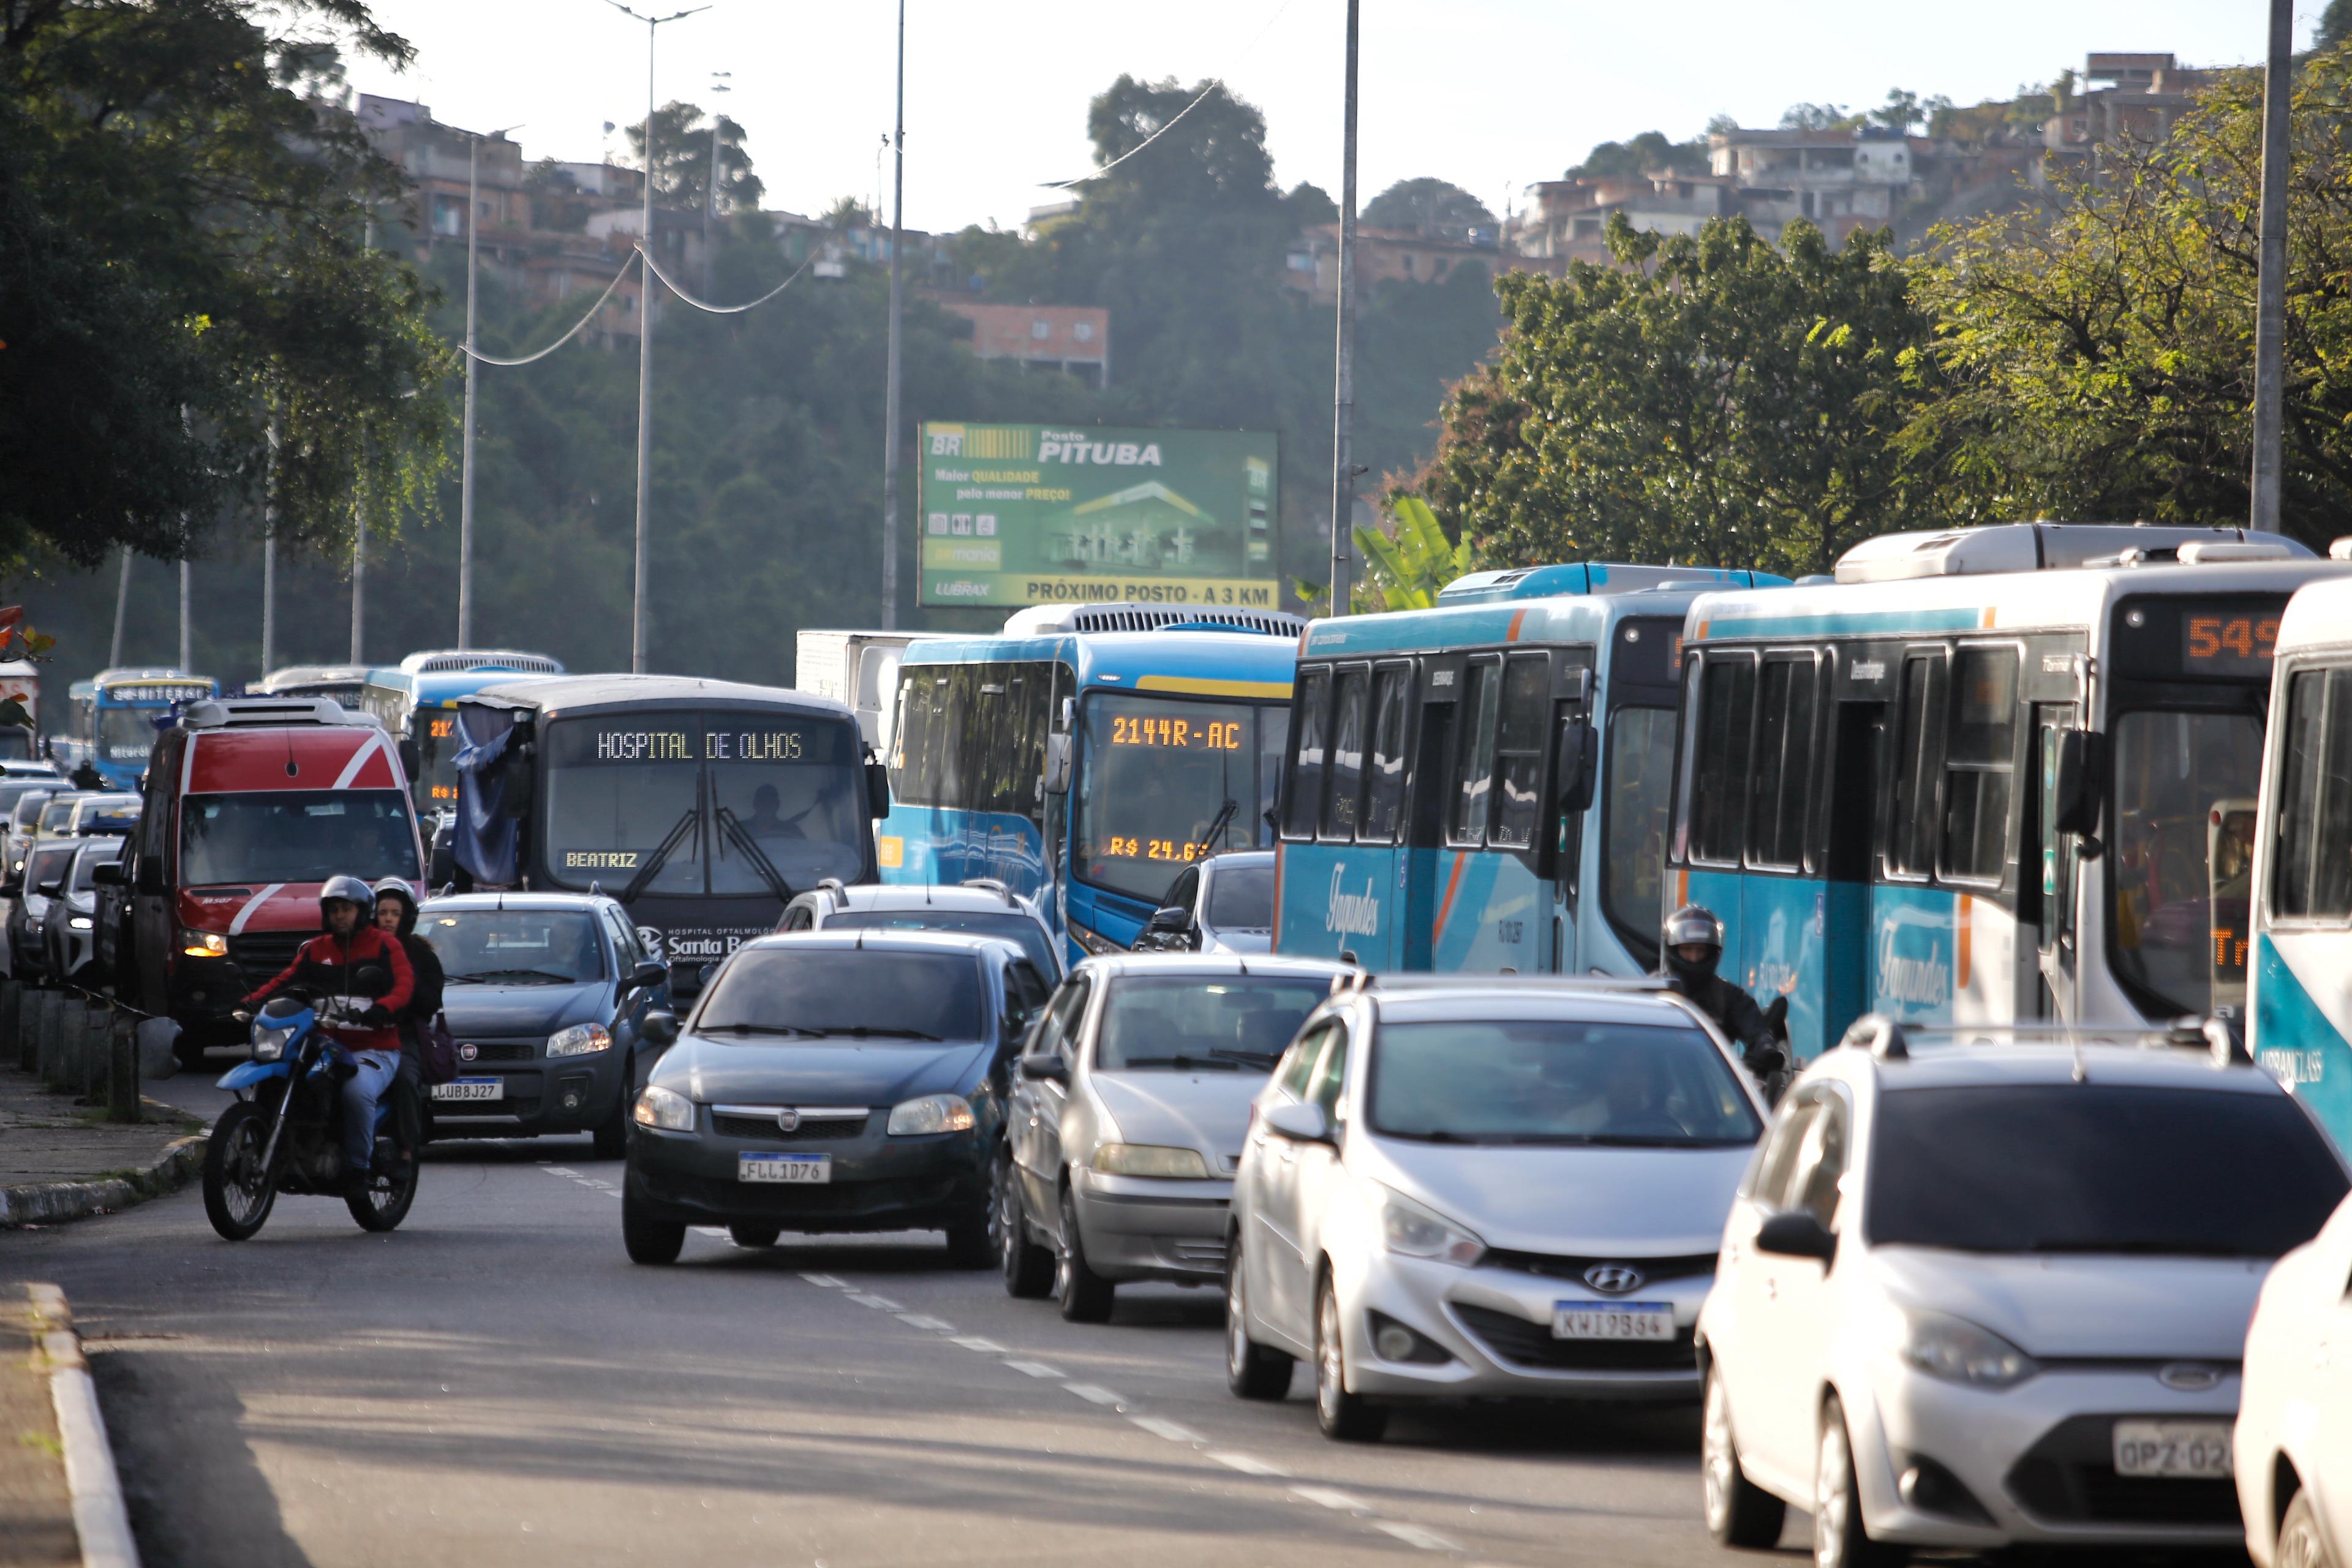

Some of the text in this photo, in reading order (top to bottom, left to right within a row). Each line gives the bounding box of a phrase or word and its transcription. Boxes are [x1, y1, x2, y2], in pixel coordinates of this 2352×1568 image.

[1041, 431, 1085, 441] Posto
[930, 435, 962, 456] BR
[1038, 442, 1161, 466] PITUBA
[935, 469, 1039, 483] Maior QUALIDADE
[957, 489, 1071, 503] pelo menor PREÇO!
[935, 582, 990, 596] LUBRAX
[1027, 579, 1118, 601] PRÓXIMO
[1125, 585, 1186, 601] POSTO
[1204, 587, 1216, 603] A
[1222, 588, 1233, 603] 3
[1240, 587, 1268, 605] KM
[2190, 617, 2280, 658] 549
[598, 732, 802, 759] HOSPITAL DE OLHOS
[431, 785, 450, 799] R$
[1110, 836, 1139, 856] R$
[566, 852, 637, 868] BEATRIZ
[1326, 862, 1379, 952] Fagundes
[668, 937, 722, 955] Santa
[668, 955, 719, 963] Oftalmologia
[1876, 918, 1948, 1022] Fagundes
[438, 1085, 495, 1098] LUB8J27
[747, 1162, 820, 1180] FLL1D76
